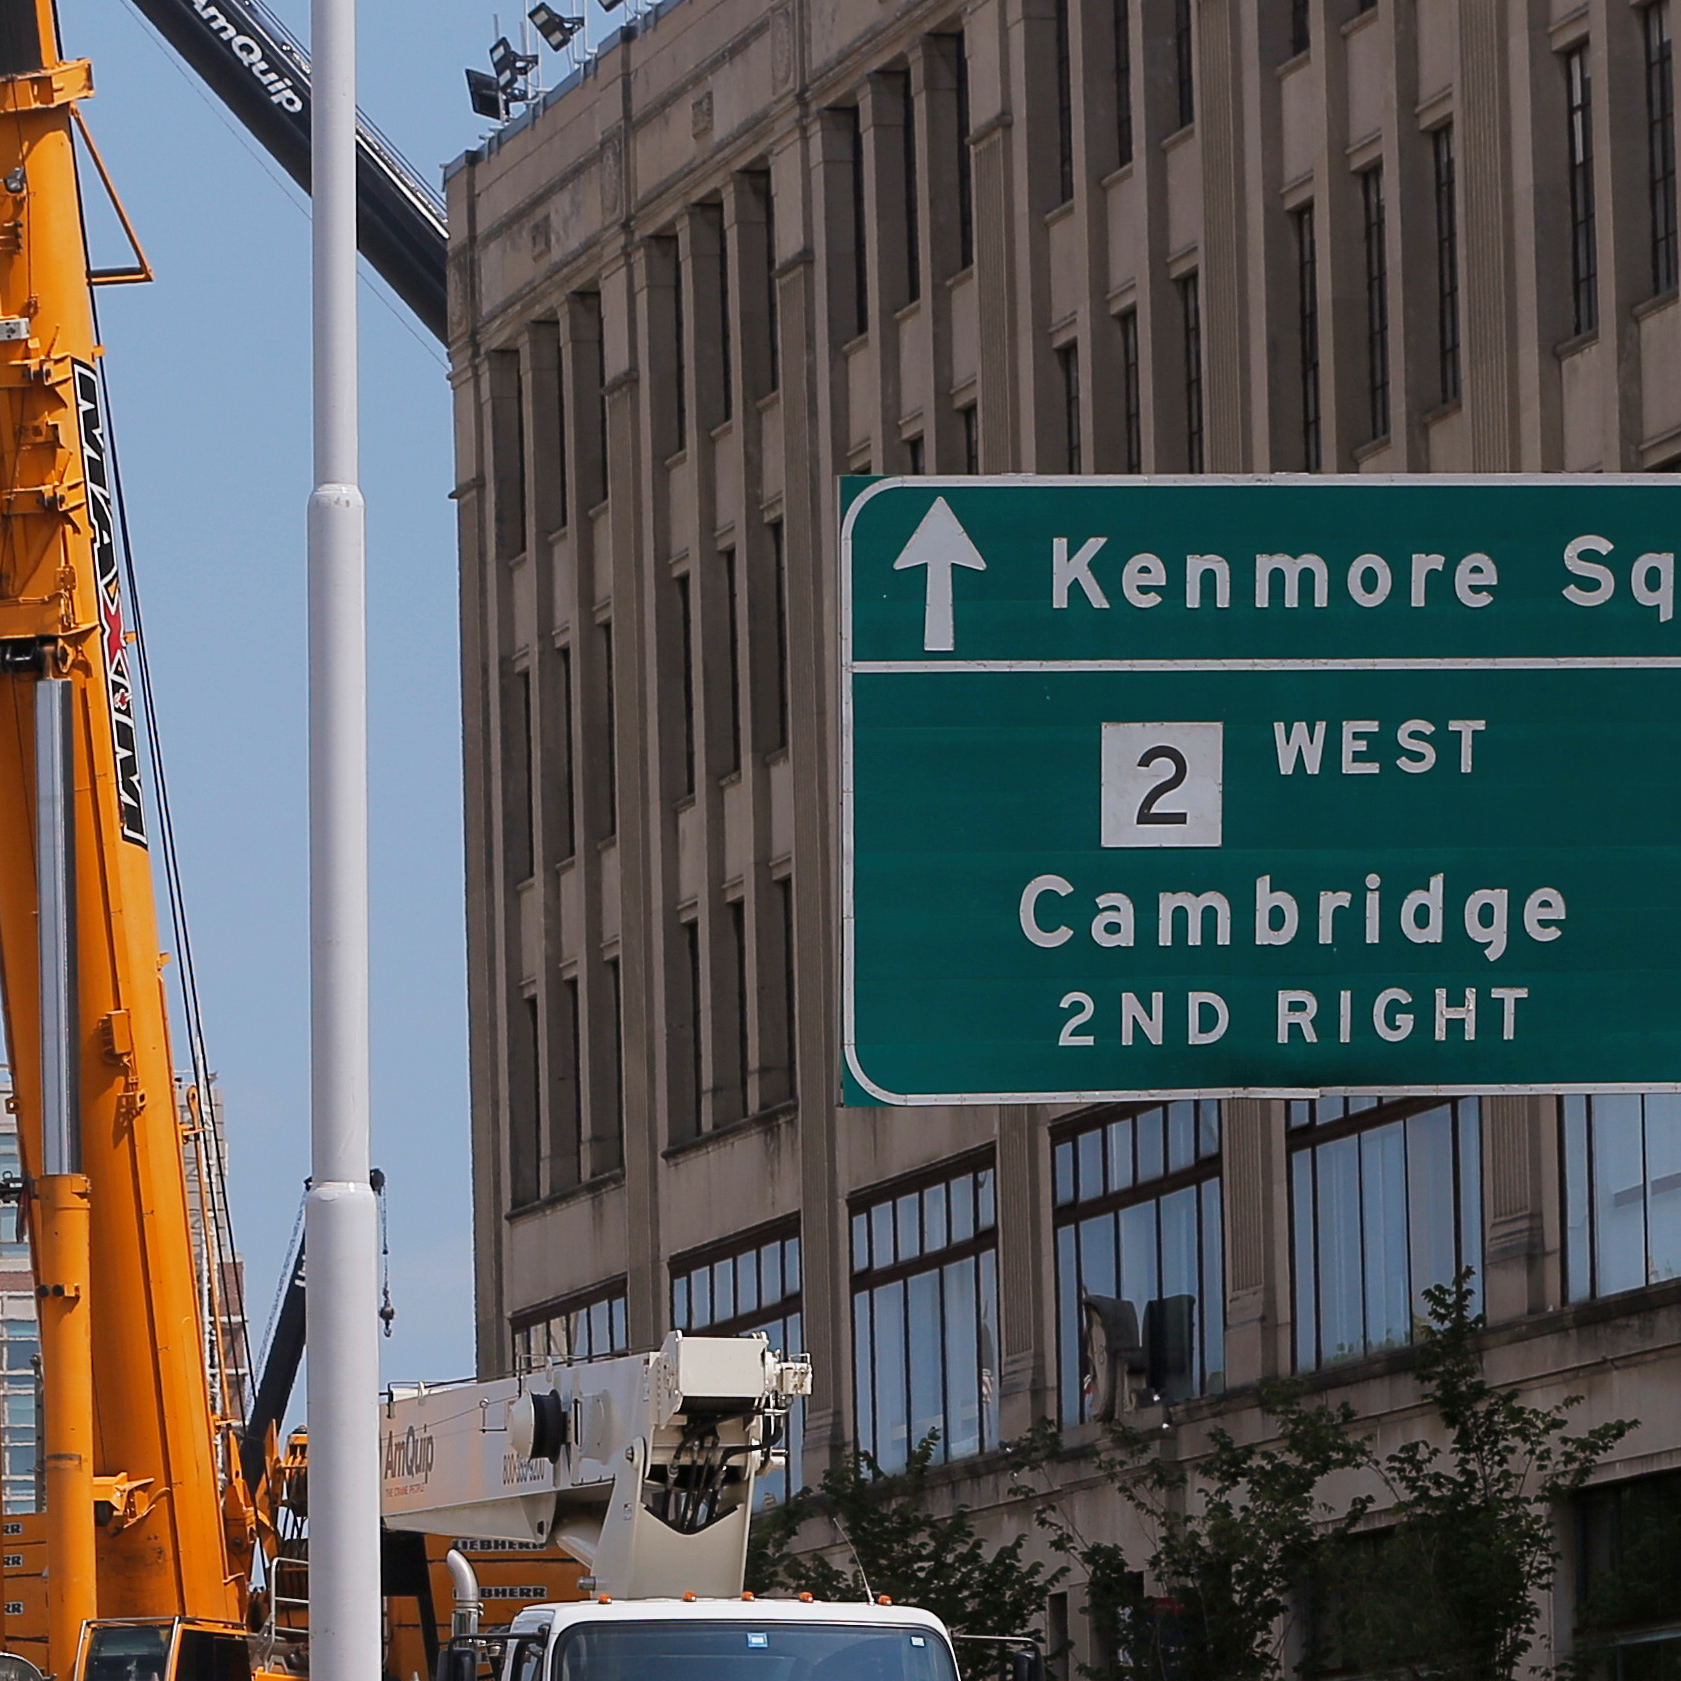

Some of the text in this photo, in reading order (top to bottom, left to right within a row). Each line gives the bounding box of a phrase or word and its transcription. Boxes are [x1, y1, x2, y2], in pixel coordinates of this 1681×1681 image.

[1051, 536, 1499, 609] Kenmore
[1273, 718, 1487, 776] WEST
[1136, 744, 1190, 826] 2
[1019, 872, 1567, 962] Cambridge
[1058, 987, 1530, 1047] 2ND RIGHT
[384, 1426, 434, 1484] AmQuip
